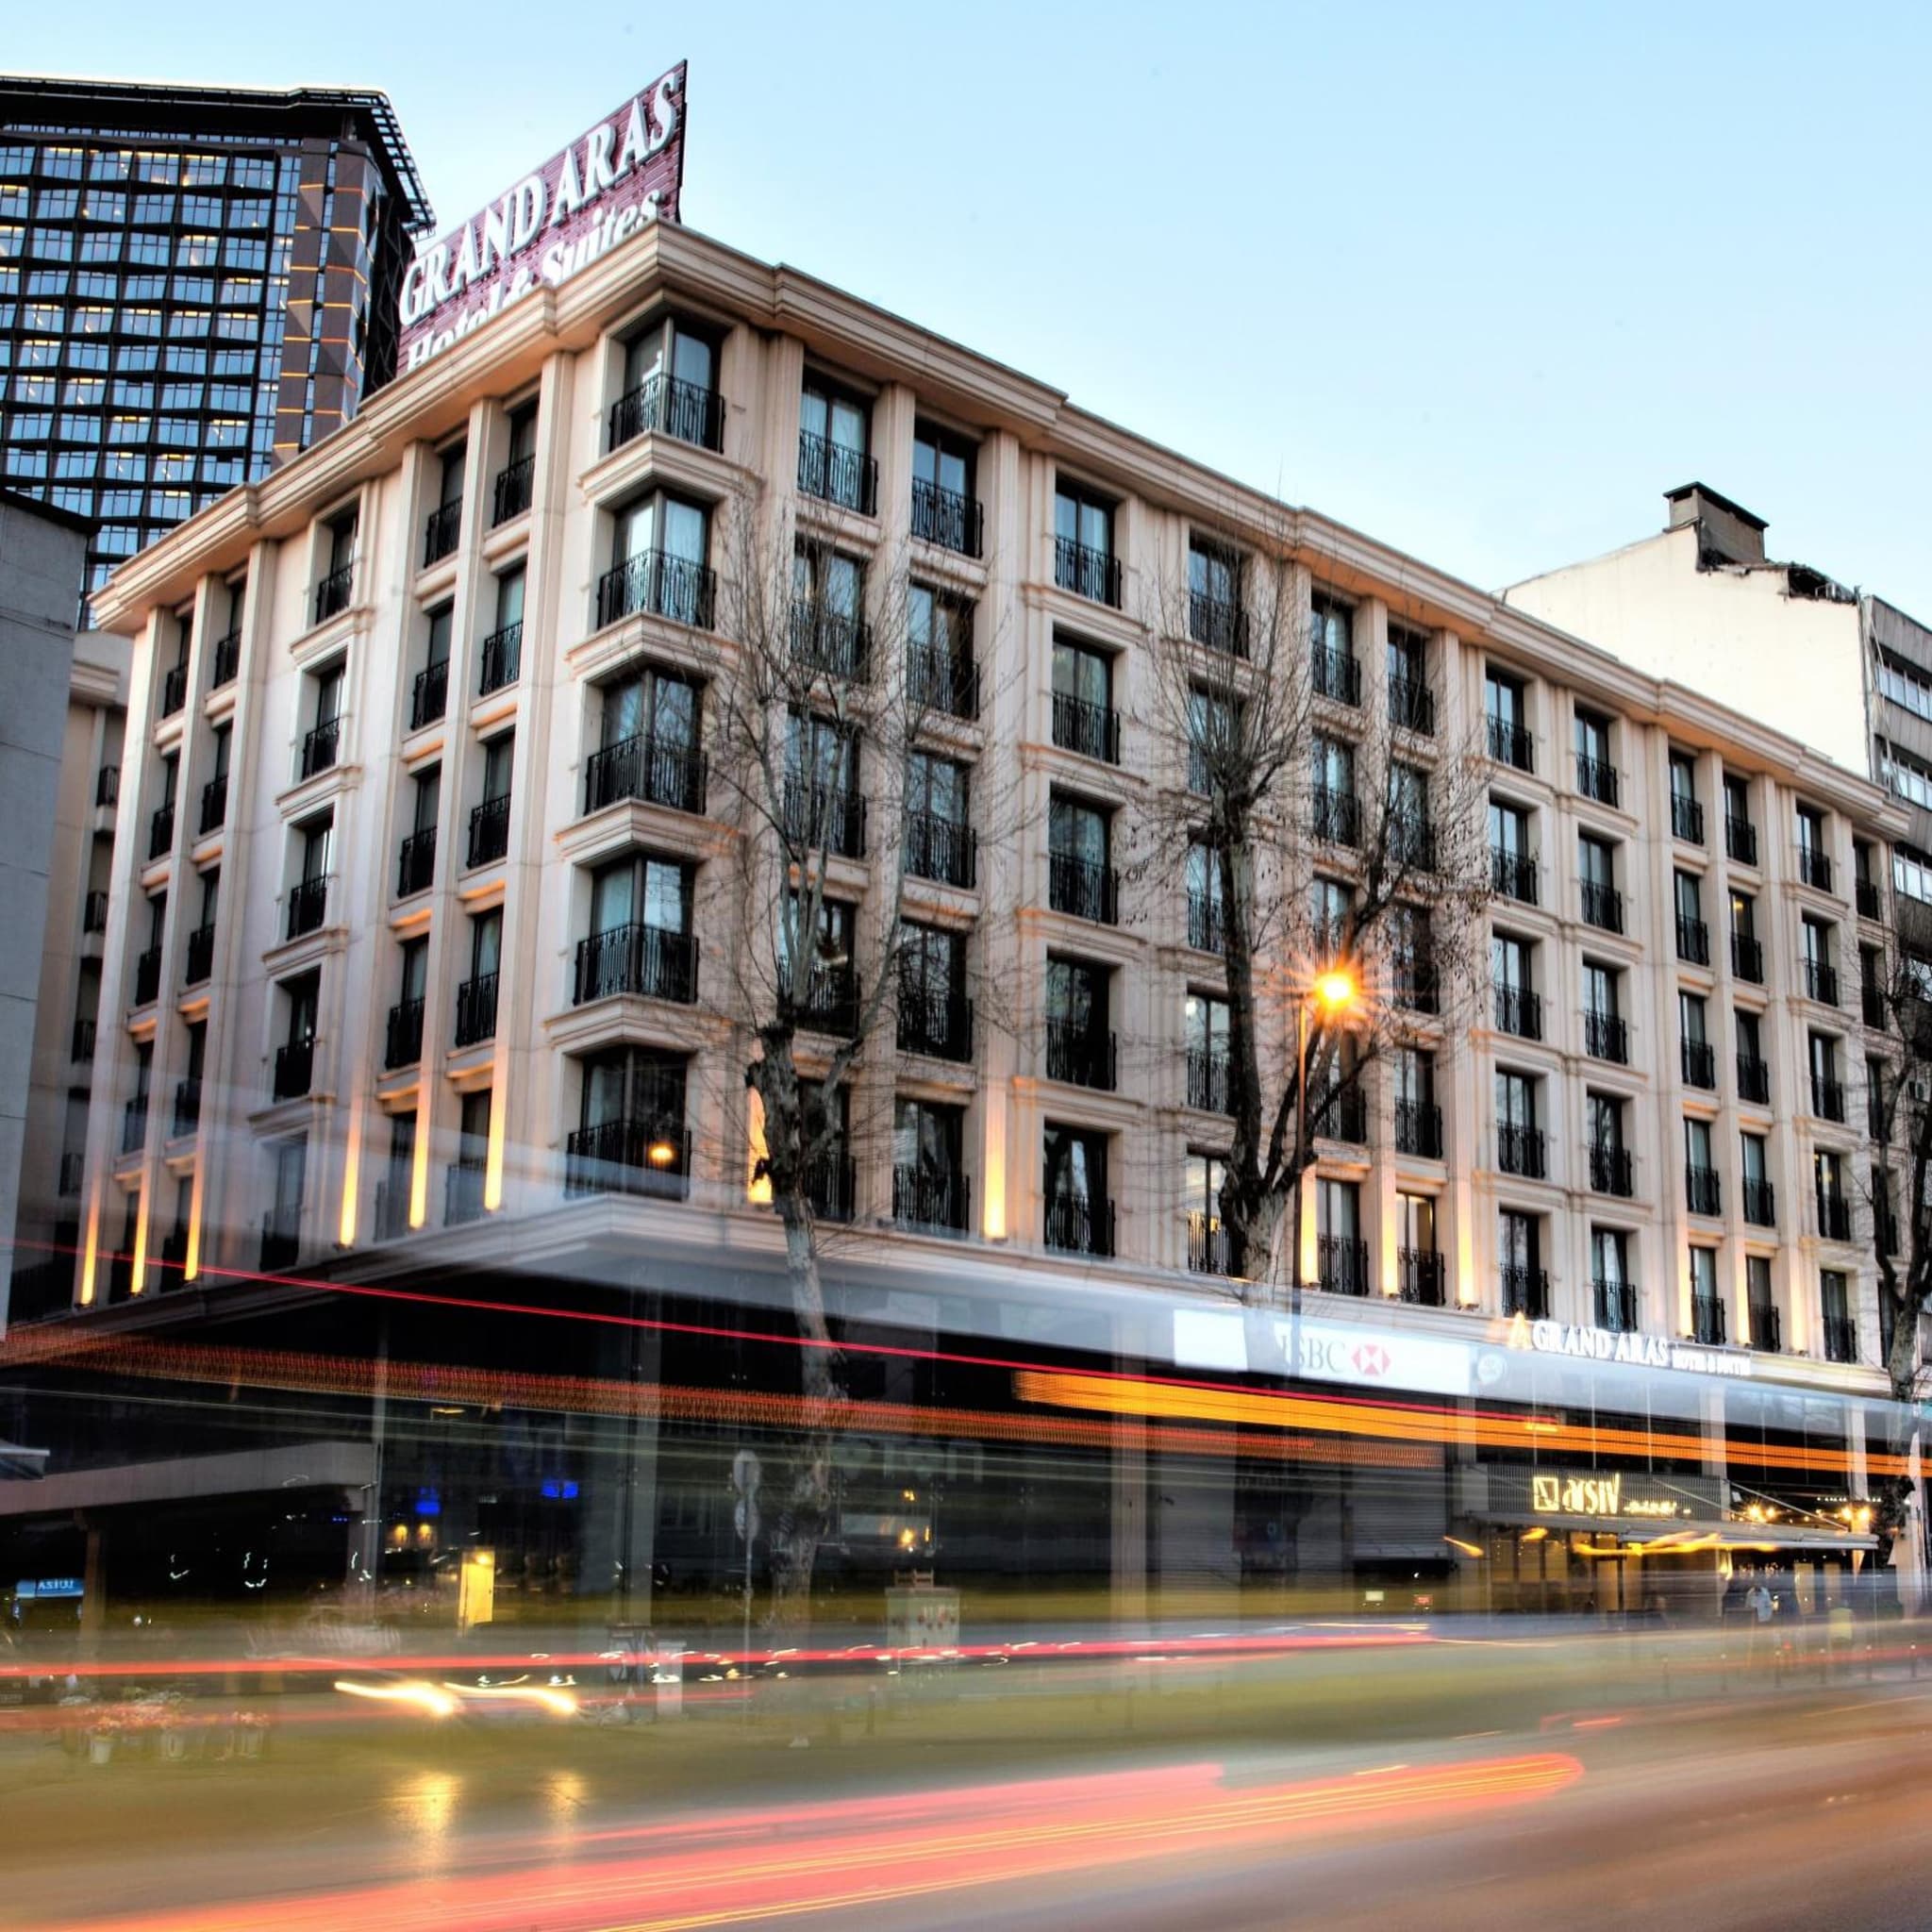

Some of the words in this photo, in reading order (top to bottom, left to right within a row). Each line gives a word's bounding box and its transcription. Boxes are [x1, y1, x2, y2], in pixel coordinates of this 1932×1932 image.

[399, 175, 546, 325] GRAND
[552, 72, 678, 228] ARAS
[542, 190, 661, 286] Suites
[1533, 1321, 1609, 1358] GRAND
[1614, 1332, 1668, 1366] ARAS
